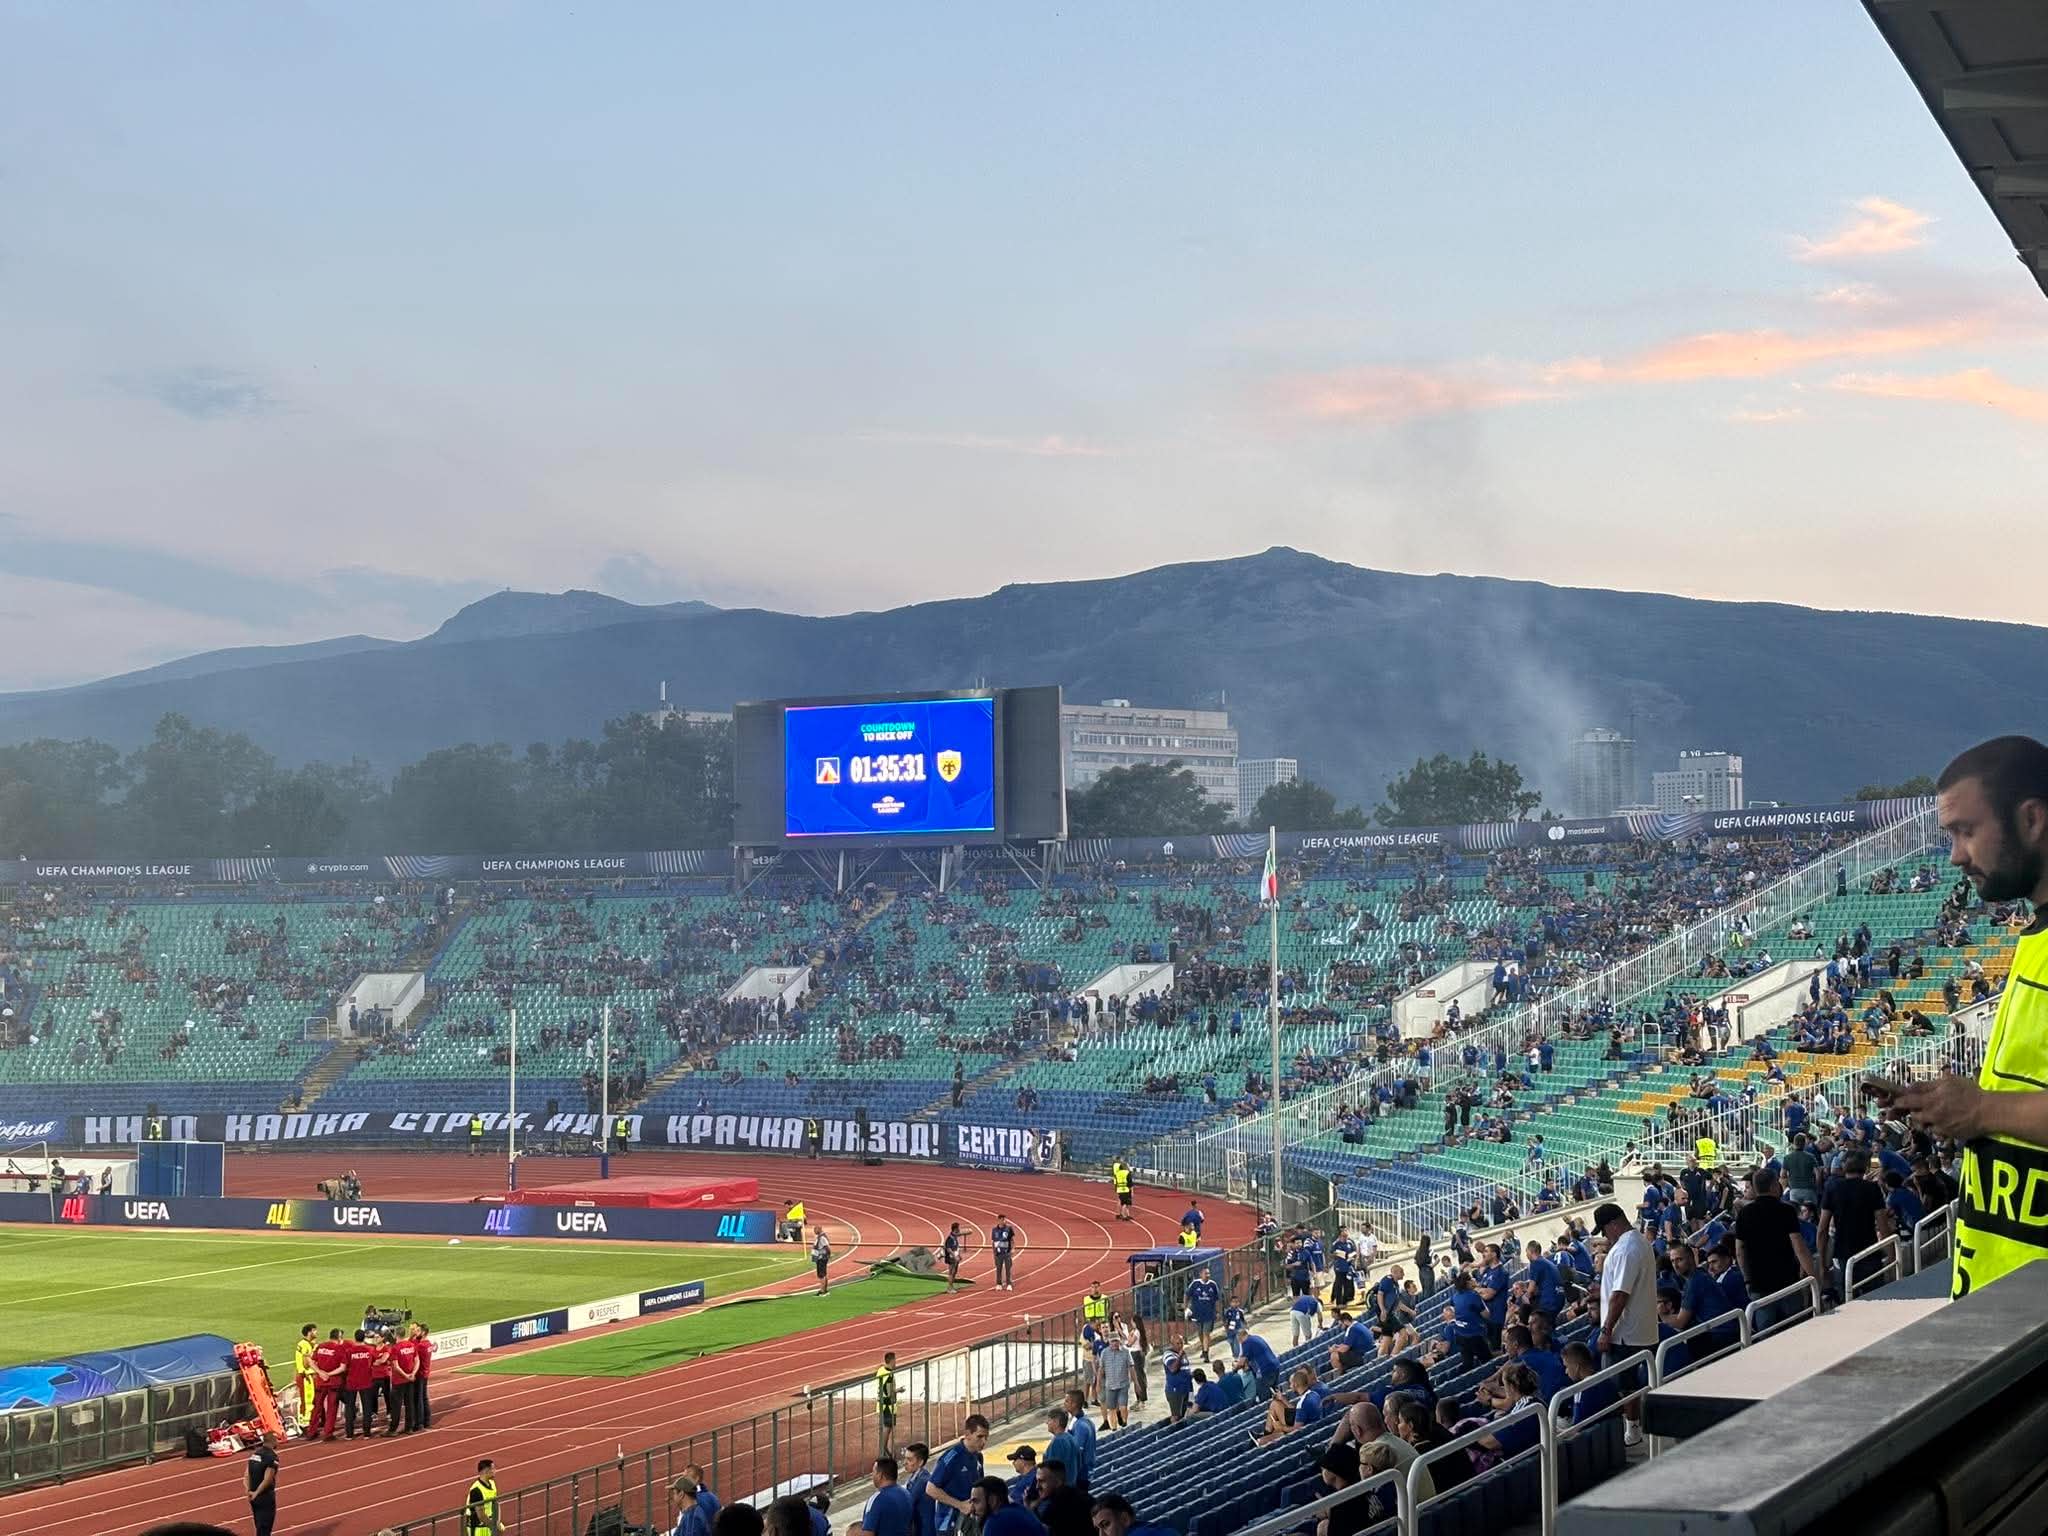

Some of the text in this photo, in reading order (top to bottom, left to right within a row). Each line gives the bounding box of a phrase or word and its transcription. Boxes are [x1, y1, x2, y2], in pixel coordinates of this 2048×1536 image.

[861, 722, 915, 732] COUNTDOWN
[863, 731, 913, 742] TO KICK OFF
[850, 753, 927, 783] 01:35:31
[1714, 810, 1856, 829] UEFA CHAMPIONS LEAGUE
[1303, 833, 1439, 848] UEFA CHAMPIONS LEAGUE
[36, 865, 191, 876] UEFA CHAMPIONS LEAGUE
[483, 858, 625, 870] UEFA CHAMPIONS LEAGUE
[225, 1112, 370, 1142] КАПКА
[667, 1115, 804, 1149] КРАЧКА
[822, 1119, 940, 1157] НАЗАД!
[958, 1124, 1033, 1158] СЕКТОР
[61, 1199, 86, 1219] ALL
[125, 1201, 170, 1220] UEFA
[265, 1204, 292, 1225] ALL
[333, 1206, 382, 1226] UEFA
[484, 1209, 511, 1231] ALL
[557, 1212, 607, 1232] UEFA
[716, 1215, 745, 1237] ALL
[644, 1288, 700, 1307] UEFA CHAMPIONS LEAGUE
[596, 1304, 620, 1317] RESPECT
[512, 1317, 549, 1338] #FOOTBALL
[317, 1347, 336, 1356] MEDIC
[400, 1346, 415, 1355] MEDIC
[440, 1335, 468, 1350] RESPECT
[351, 1351, 370, 1360] MEDIC
